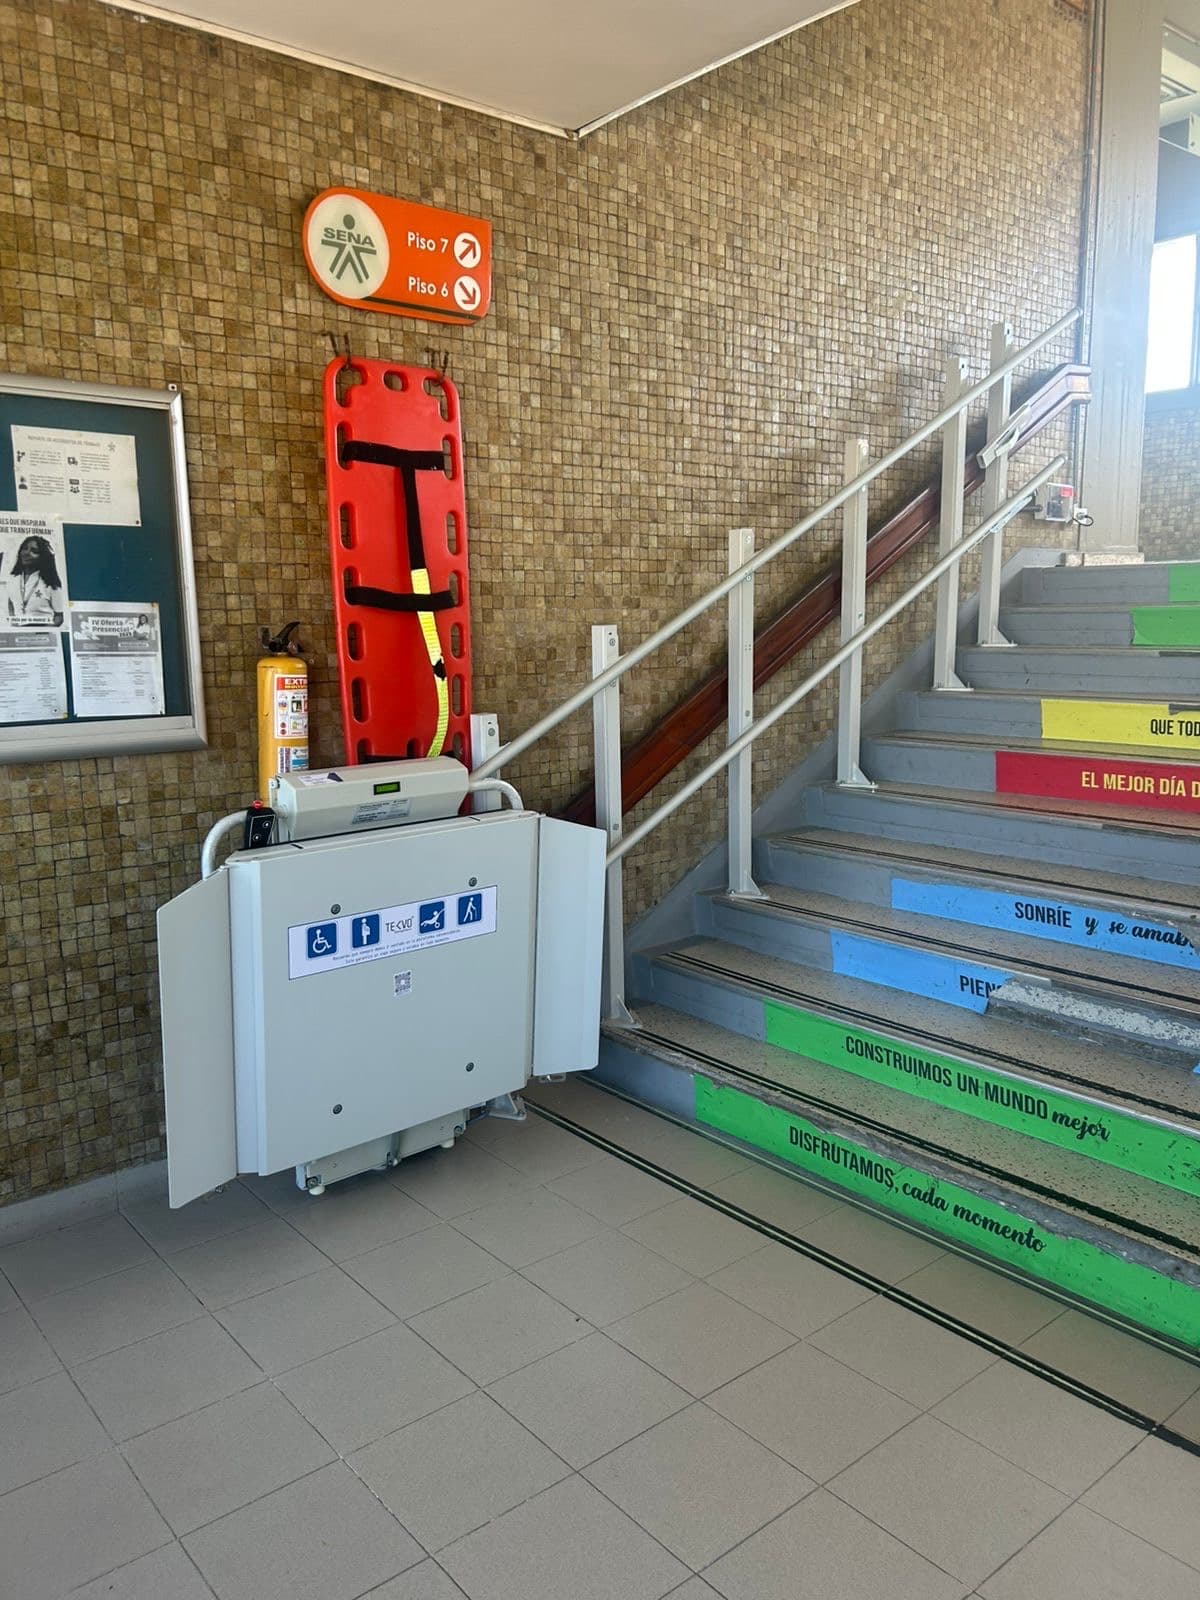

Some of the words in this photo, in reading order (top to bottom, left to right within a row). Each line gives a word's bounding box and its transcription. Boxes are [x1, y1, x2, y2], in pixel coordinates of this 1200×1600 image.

[323, 227, 375, 248] SENA
[407, 231, 436, 251] Piso
[440, 238, 449, 253] 7
[408, 276, 437, 296] Piso
[440, 282, 449, 298] 6
[1150, 719, 1174, 736] QUE
[1082, 771, 1099, 789] EL
[1103, 773, 1155, 794] MEJOR
[1159, 776, 1186, 797] DÍA
[1015, 901, 1072, 929] SONRÍE
[1085, 916, 1099, 935] y
[1108, 921, 1126, 935] se
[959, 974, 1002, 999] PIEN
[845, 1035, 953, 1088] CONSTRUIMOS
[957, 1071, 980, 1097] UN
[984, 1081, 1048, 1120] MUNDO
[1051, 1110, 1111, 1142] mejor
[789, 1125, 899, 1194] DISFRUTAMOS,
[902, 1182, 949, 1212] cada
[952, 1203, 1047, 1253] momento
